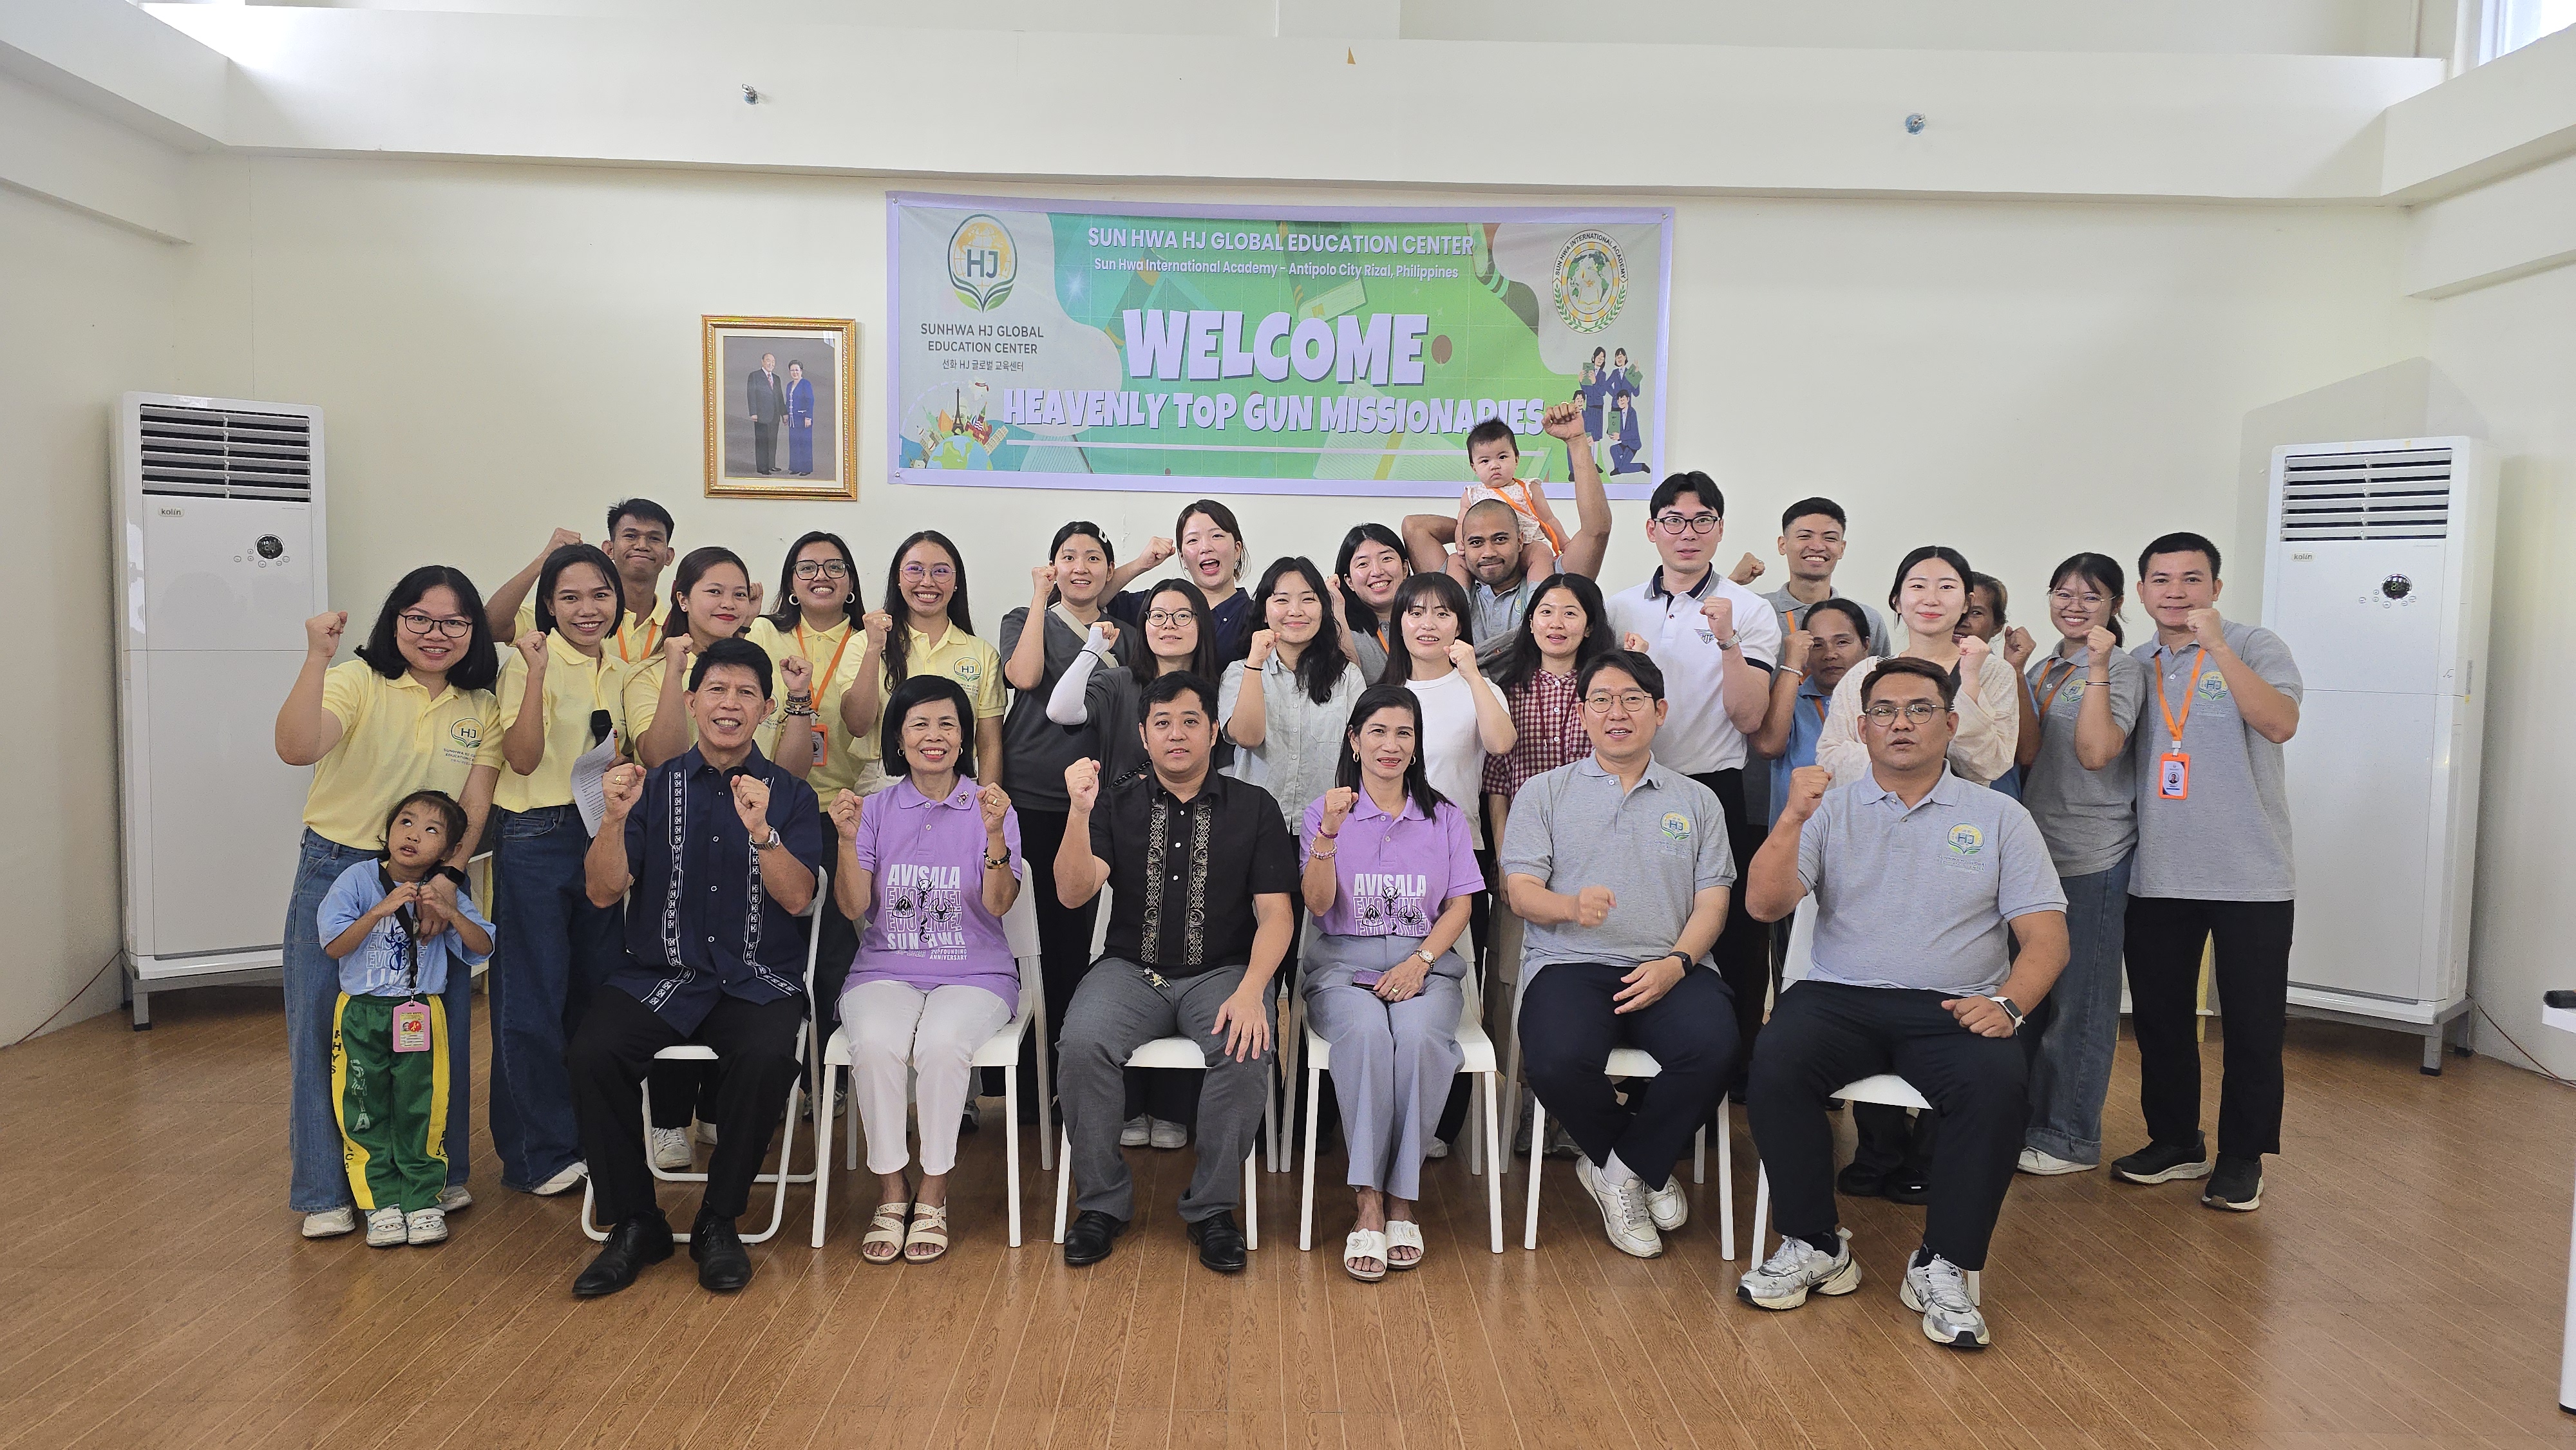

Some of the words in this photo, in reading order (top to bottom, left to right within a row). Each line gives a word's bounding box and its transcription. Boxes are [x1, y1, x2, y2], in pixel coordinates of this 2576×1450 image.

[1088, 227, 1126, 247] SUN
[1132, 229, 1178, 249] HWA
[1182, 231, 1206, 250] HJ
[1211, 232, 1283, 252] GLOBAL
[1288, 234, 1397, 254] EDUCATION
[1402, 235, 1473, 256] CENTER
[967, 249, 998, 279] HJ
[1571, 233, 1613, 247] INTERNATIONAL
[1612, 246, 1626, 279] ACADEMY
[1094, 258, 1116, 270] Sun
[1119, 258, 1143, 272] Hwa
[1146, 259, 1220, 274] International
[1222, 261, 1278, 278] Academy
[1288, 262, 1336, 279] Antipolo
[1339, 263, 1362, 281] City
[1364, 264, 1394, 279] Rizal,
[1396, 265, 1459, 282] Philippines
[921, 323, 975, 336] SUNHWA
[978, 325, 993, 337] HJ
[997, 325, 1044, 338] GLOBAL
[928, 341, 991, 353] EDUCATION
[994, 343, 1037, 354] CENTER
[1122, 308, 1429, 386] WELCOME
[942, 359, 957, 370] 선화
[960, 360, 970, 370] HJ
[972, 359, 993, 371] 글로벌
[995, 361, 1024, 372] 교육센터
[1003, 388, 1169, 429] HEAVENLY
[1173, 391, 1237, 430] TOP
[1243, 393, 1313, 433] GUN
[1320, 395, 1545, 437] MISSIONARIES
[2206, 679, 2222, 690] HJ
[461, 728, 477, 739] HJ
[1669, 820, 1683, 831] HJ
[1957, 833, 1975, 845] HJ
[887, 863, 961, 889] AVISALA
[1353, 873, 1426, 898] AVISALA
[887, 932, 920, 950] SUN
